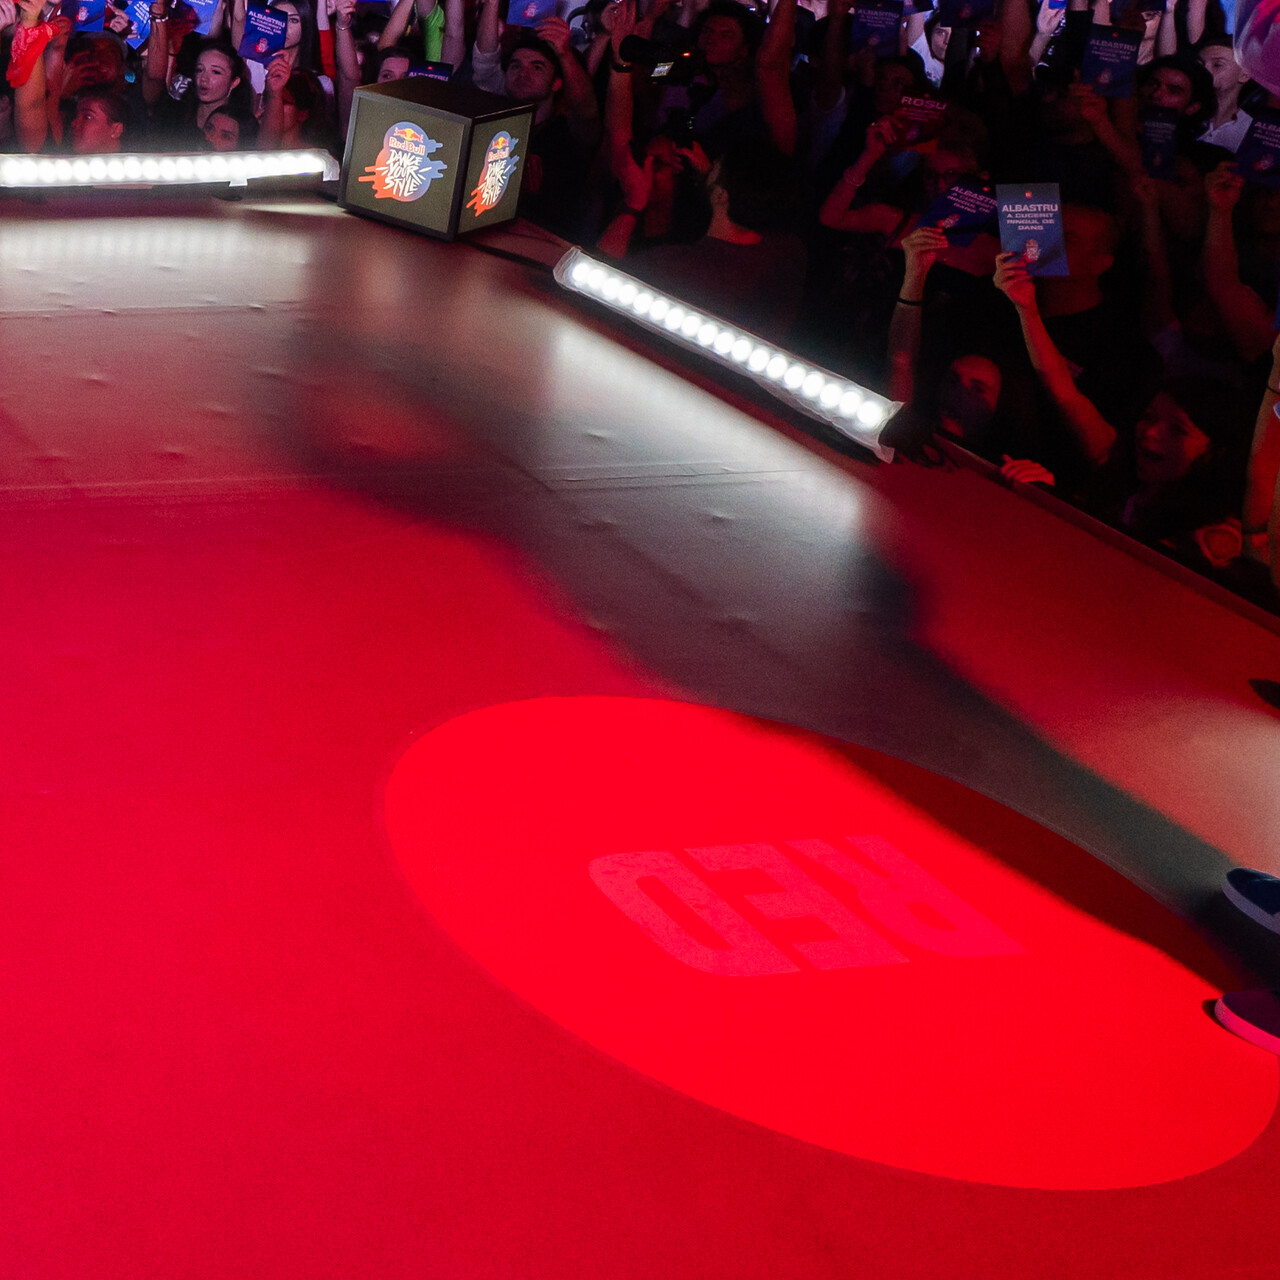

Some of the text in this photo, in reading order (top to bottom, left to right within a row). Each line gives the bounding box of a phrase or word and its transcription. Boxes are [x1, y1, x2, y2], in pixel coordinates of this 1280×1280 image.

[389, 137, 426, 156] Red Bull
[387, 150, 422, 168] DANCE
[388, 161, 420, 179] YOUR
[383, 176, 426, 197] STYLE
[1002, 204, 1059, 212] ALBASTRU
[588, 833, 1030, 978] RED
